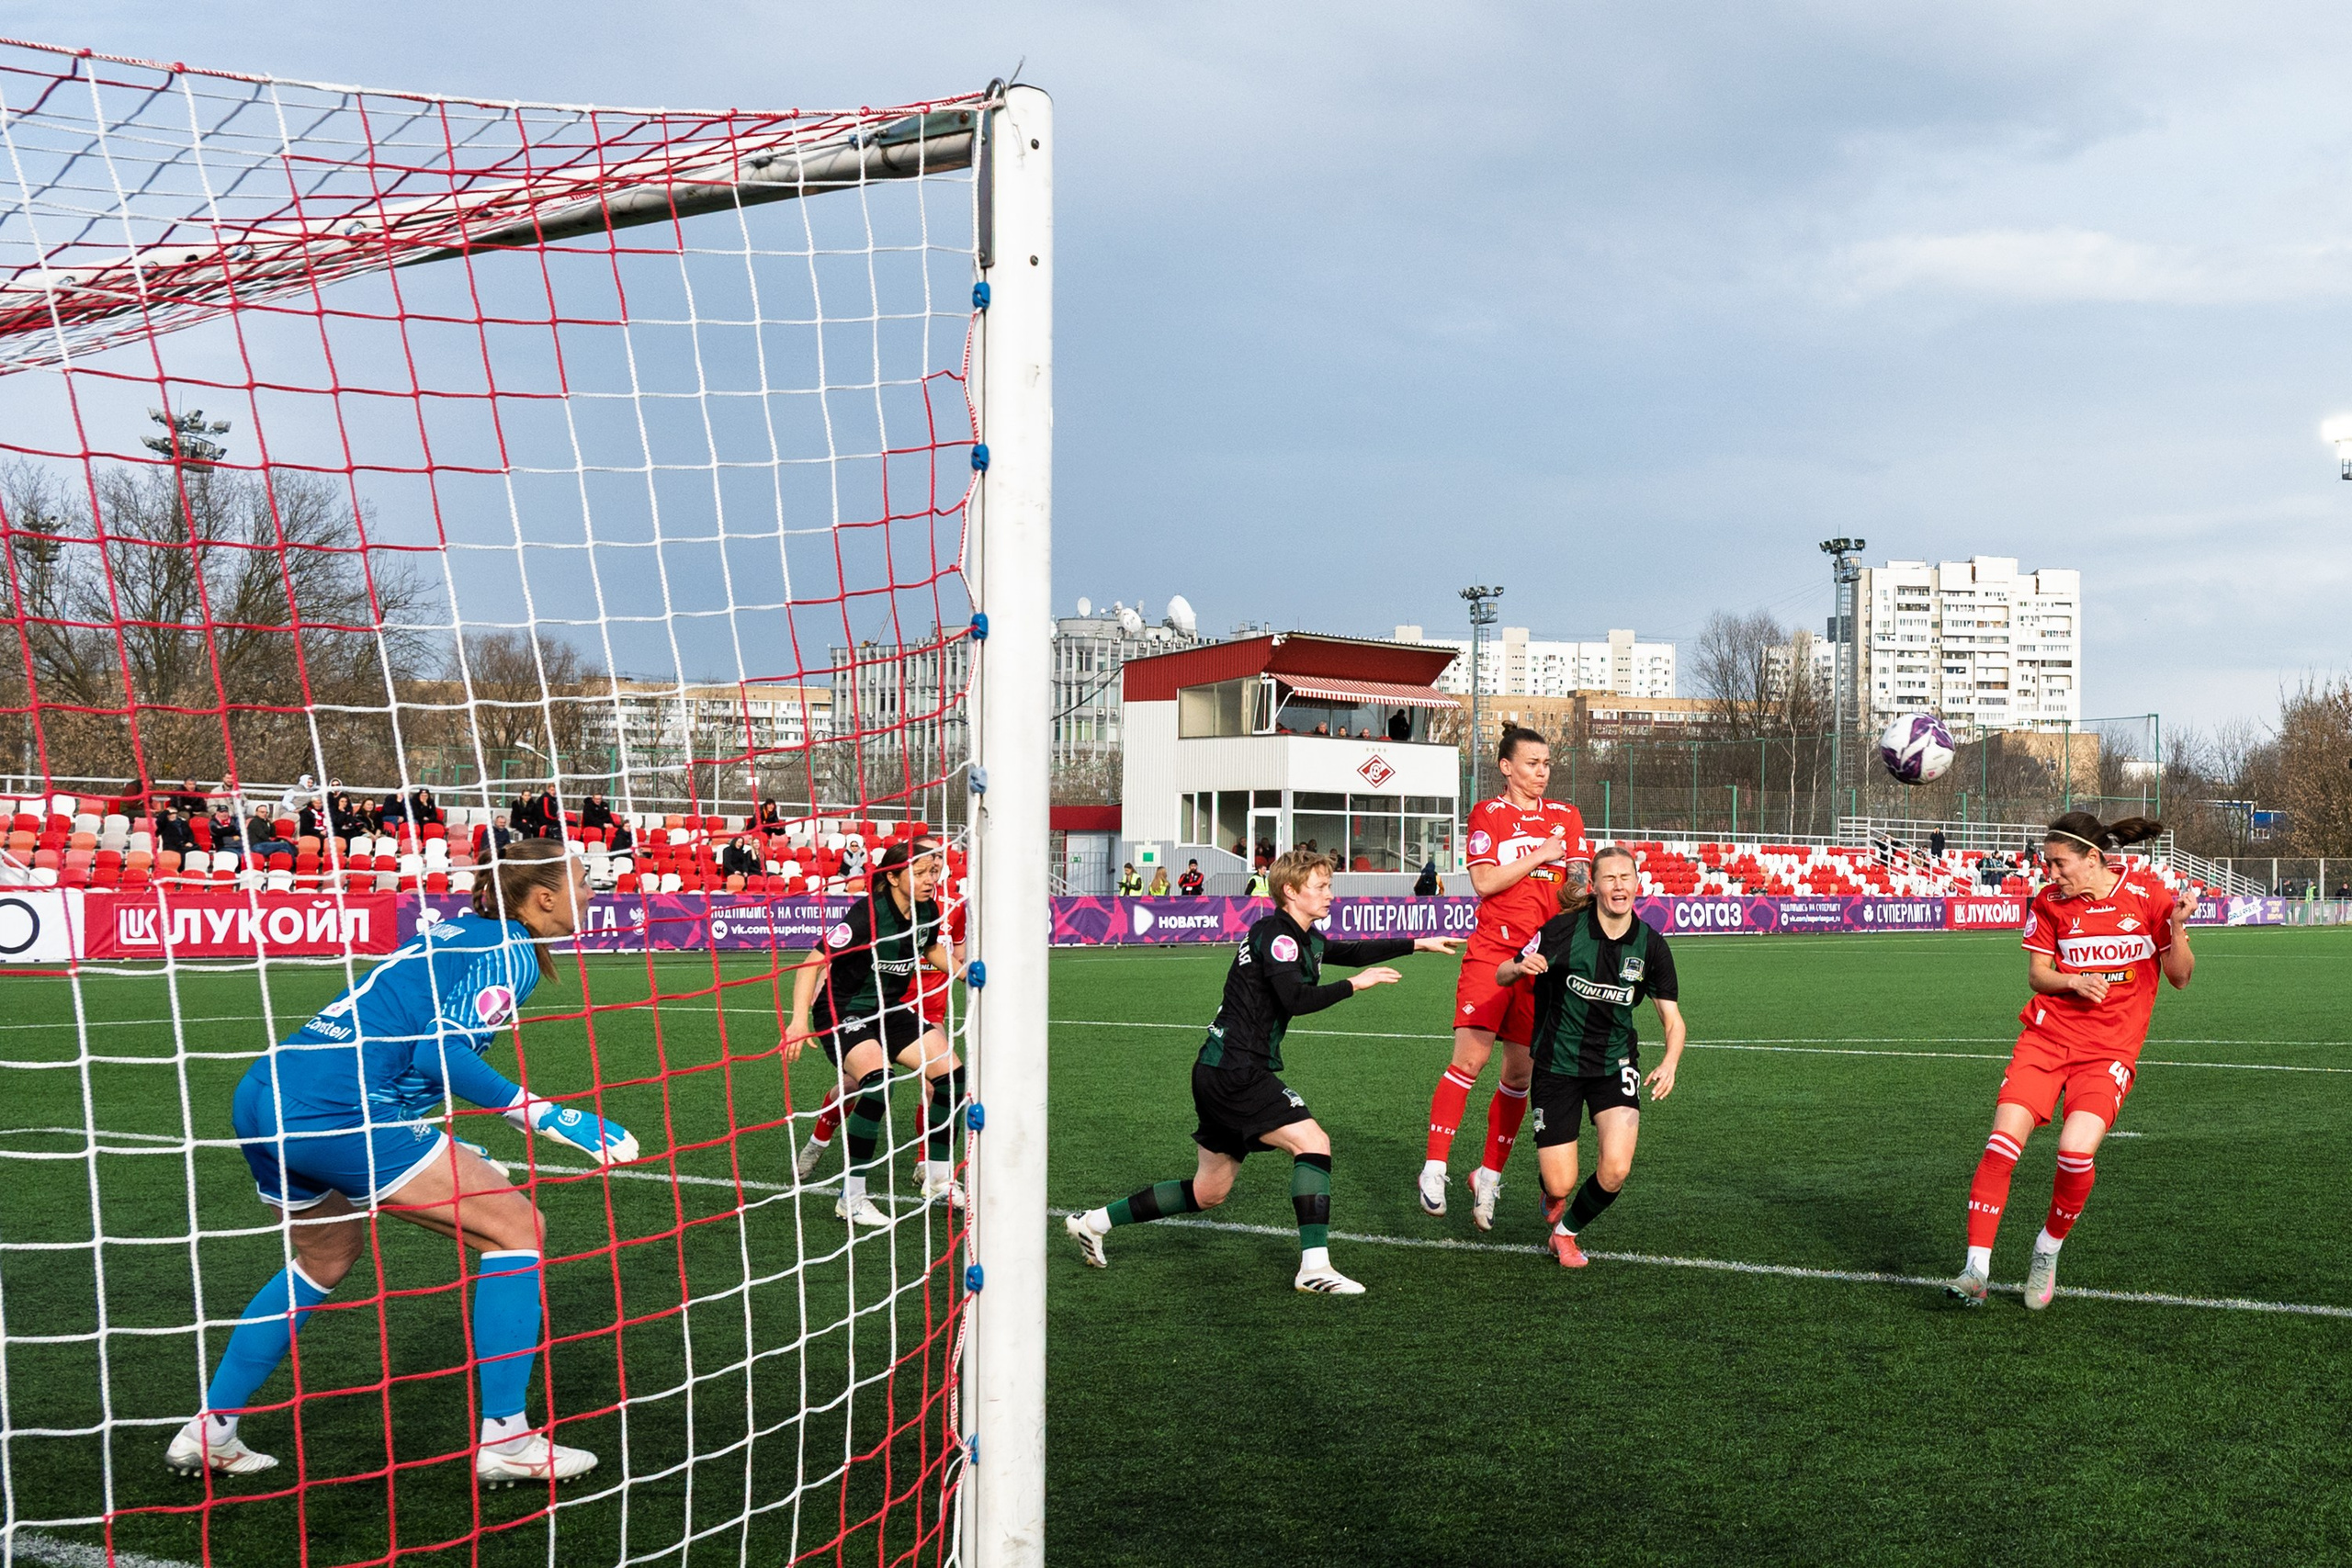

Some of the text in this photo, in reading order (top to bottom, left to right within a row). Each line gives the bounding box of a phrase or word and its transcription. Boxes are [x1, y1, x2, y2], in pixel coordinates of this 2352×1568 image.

[168, 899, 370, 945] ЛУКОЙЛ
[777, 906, 792, 919] НА
[1158, 915, 1220, 930] НОВАТЭК
[1341, 904, 1478, 931] СУПЕРЛИГА 202
[1876, 904, 1932, 923] СУПЕРЛИГА
[1967, 900, 2020, 923] ЛУКОЙЛ
[1571, 979, 1624, 1002] WINLINE
